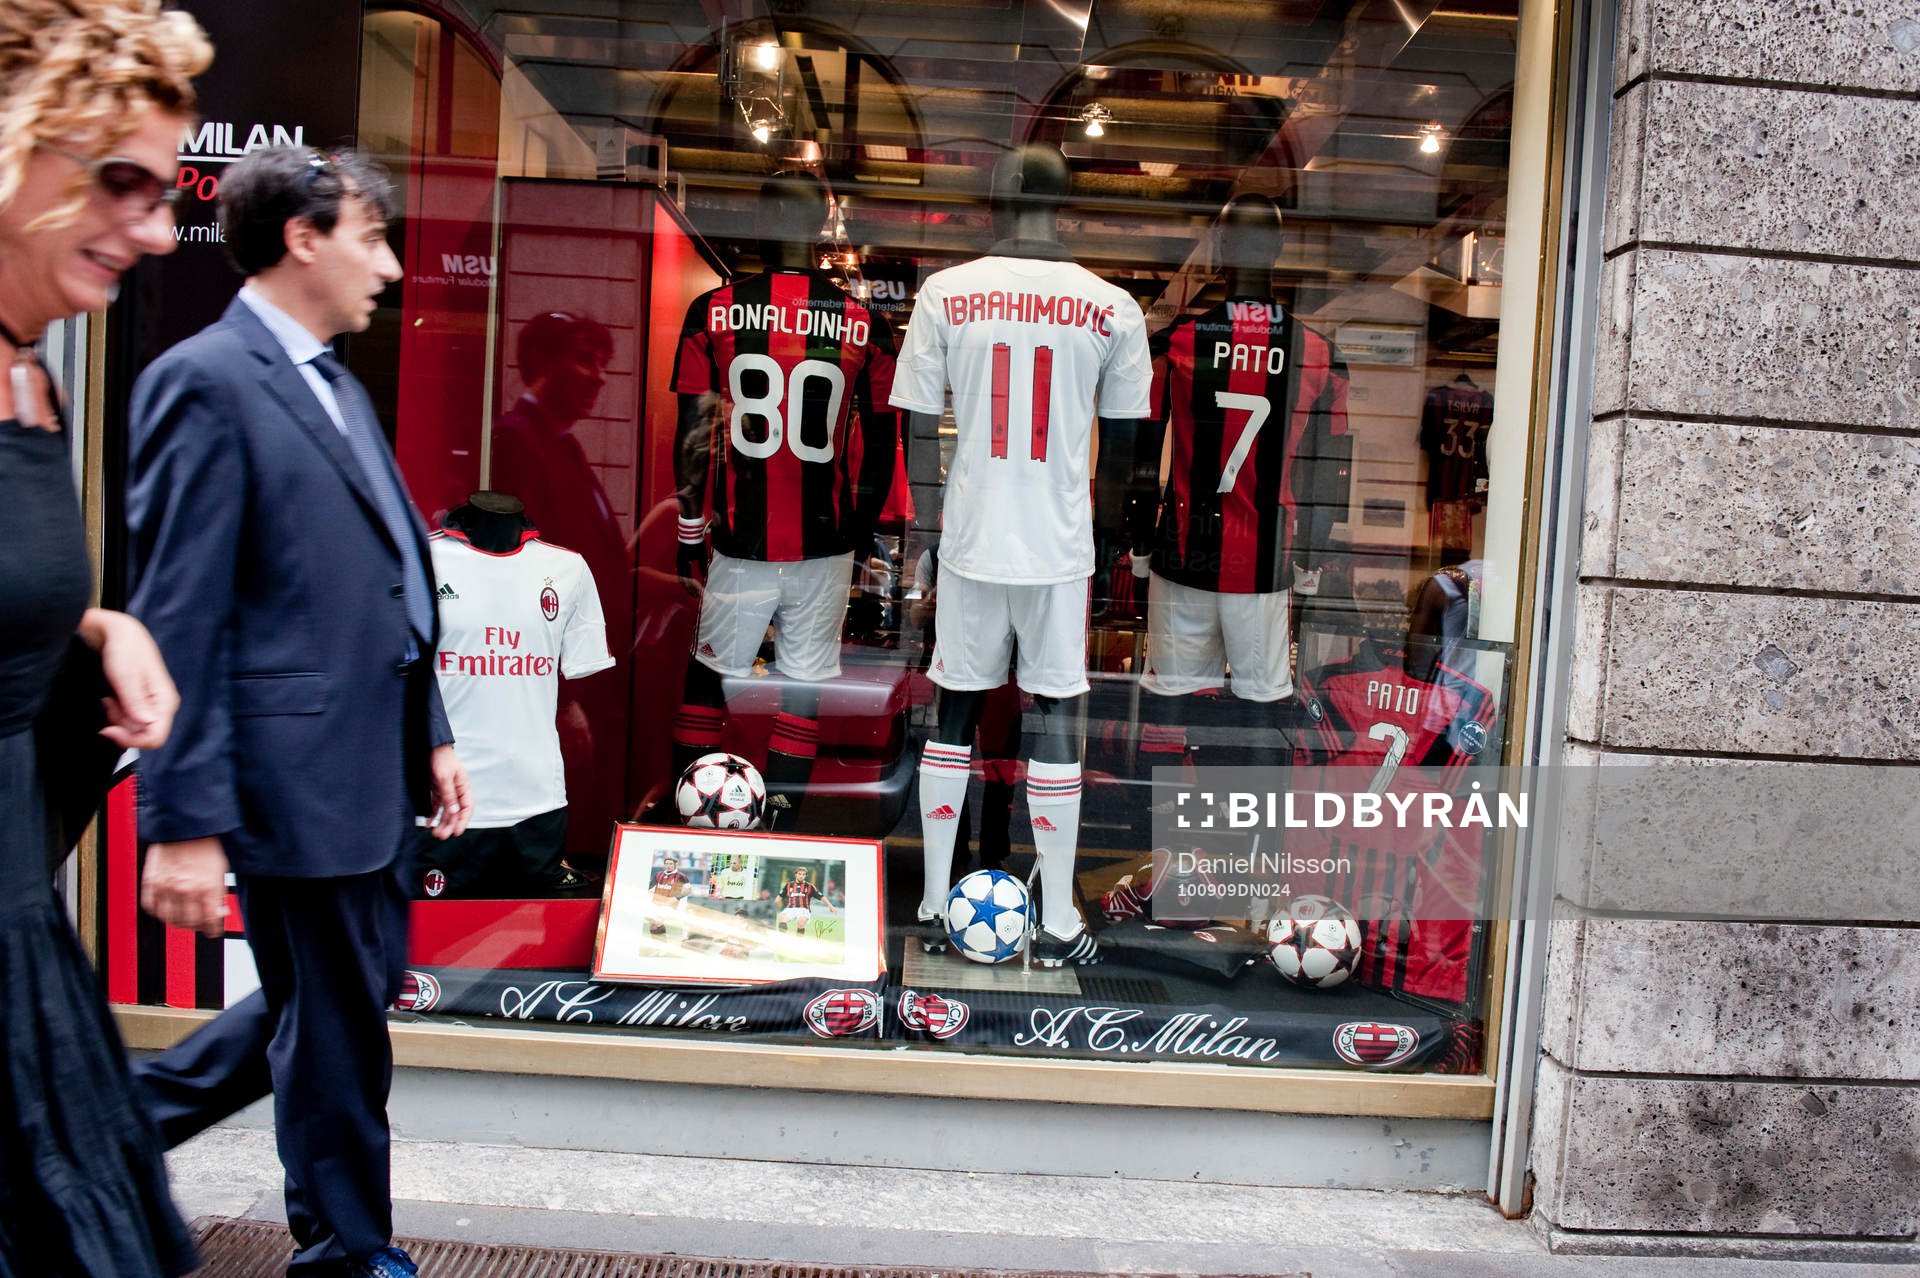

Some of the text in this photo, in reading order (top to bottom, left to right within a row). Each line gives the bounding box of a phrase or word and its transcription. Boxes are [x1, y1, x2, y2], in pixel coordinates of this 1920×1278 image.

[176, 122, 303, 155] MILAN
[711, 303, 870, 347] RONALDINHO
[943, 291, 1115, 338] IBRAHIMOVIĆ
[1213, 341, 1285, 375] PATO
[728, 353, 846, 463] 80
[990, 342, 1054, 462] 11
[1215, 391, 1271, 493] 7
[1440, 418, 1480, 458] 33
[485, 627, 521, 650] Fly
[438, 649, 554, 677] Emirates
[1367, 680, 1420, 716] PATO
[413, 978, 433, 1009] ACM
[811, 1001, 827, 1028] ACM
[948, 1001, 961, 1029] ACM
[1132, 1013, 1280, 1062] Milan
[1340, 1026, 1357, 1056] ACM
[1397, 1029, 1409, 1053] 1899
